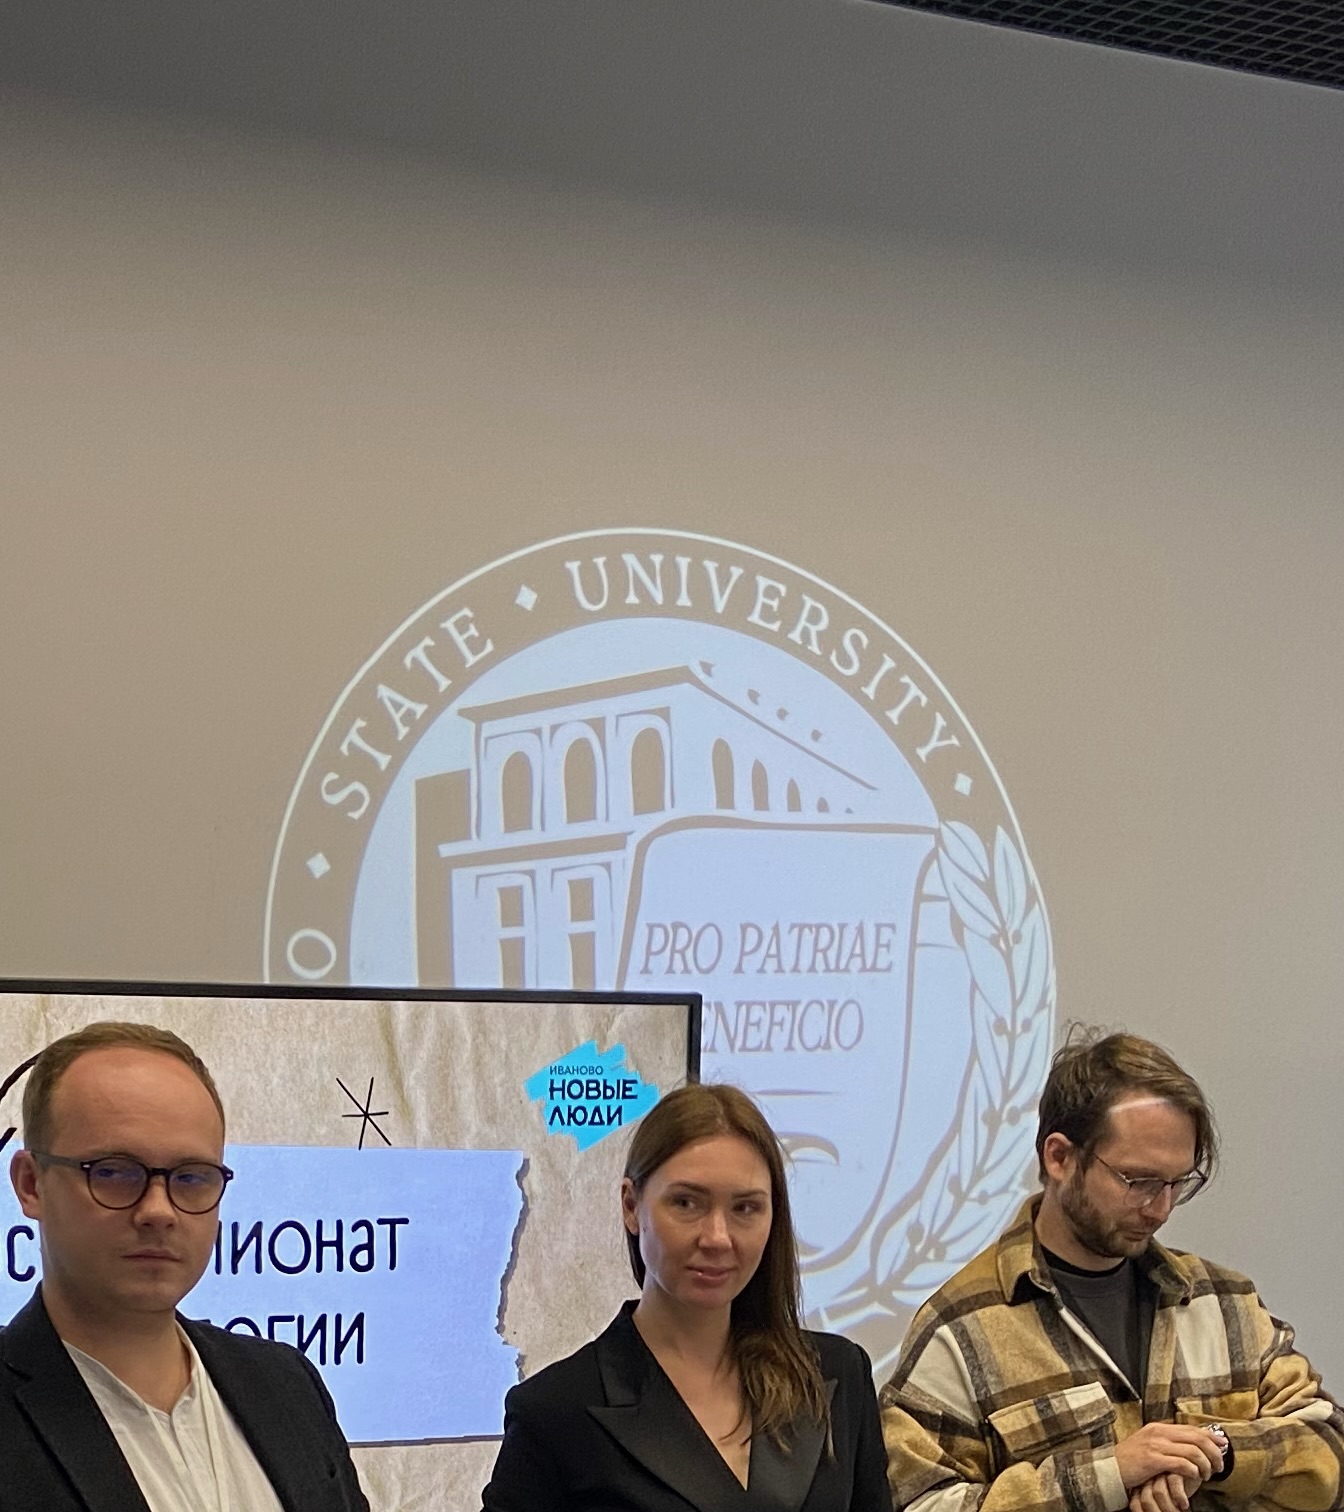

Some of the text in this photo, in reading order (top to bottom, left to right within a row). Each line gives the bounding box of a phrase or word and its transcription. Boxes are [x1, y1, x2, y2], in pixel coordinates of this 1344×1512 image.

[321, 554, 960, 820] STATE UNIVERSITY
[639, 920, 897, 975] PRO PATRIAE
[702, 999, 865, 1053] NEFICIO
[548, 1078, 638, 1101] НОВЫЕ
[549, 1065, 604, 1076] ИВАНОВО
[548, 1104, 623, 1127] ЛЮДИ
